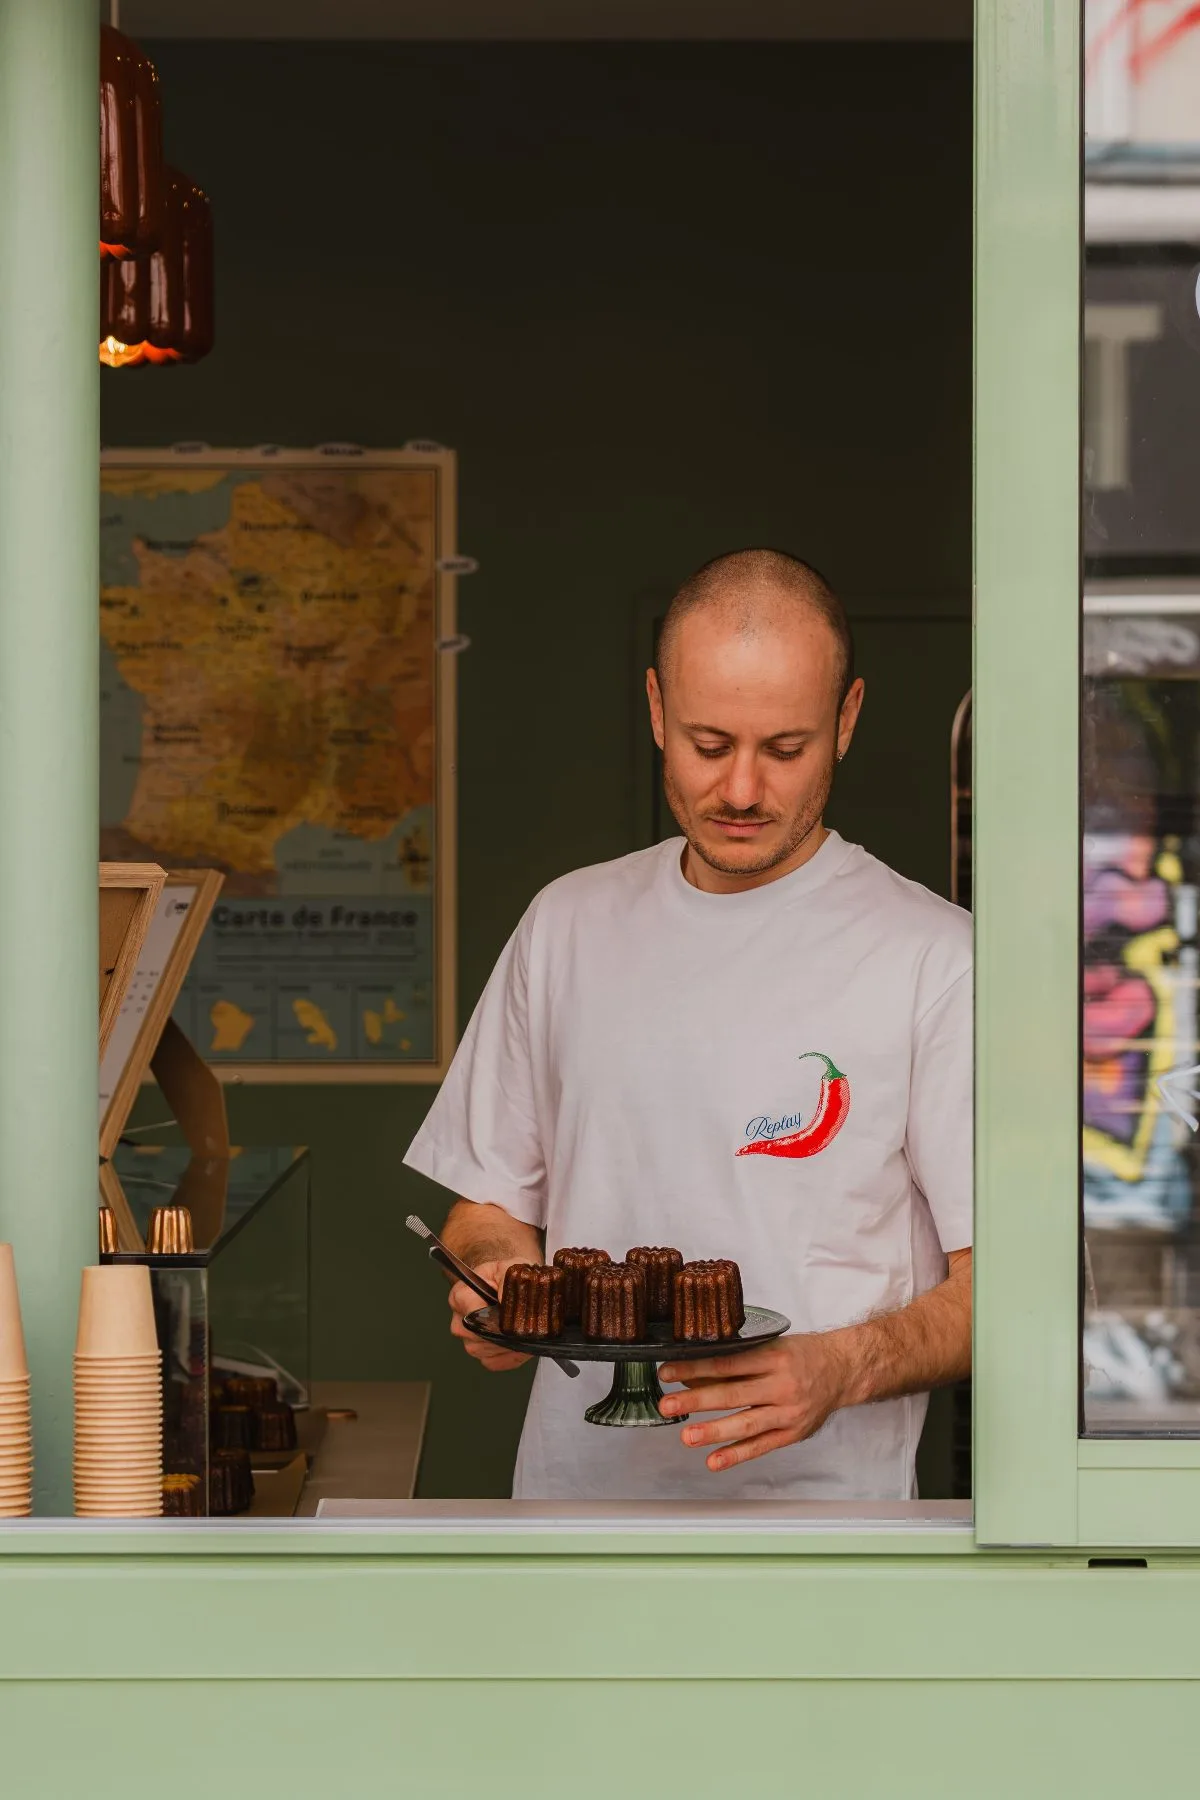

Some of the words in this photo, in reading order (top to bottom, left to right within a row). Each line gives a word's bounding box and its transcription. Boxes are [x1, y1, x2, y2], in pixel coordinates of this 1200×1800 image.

[212, 905, 285, 928] Carte
[292, 904, 324, 928] de
[330, 904, 419, 928] France
[745, 1112, 802, 1140] Replay
